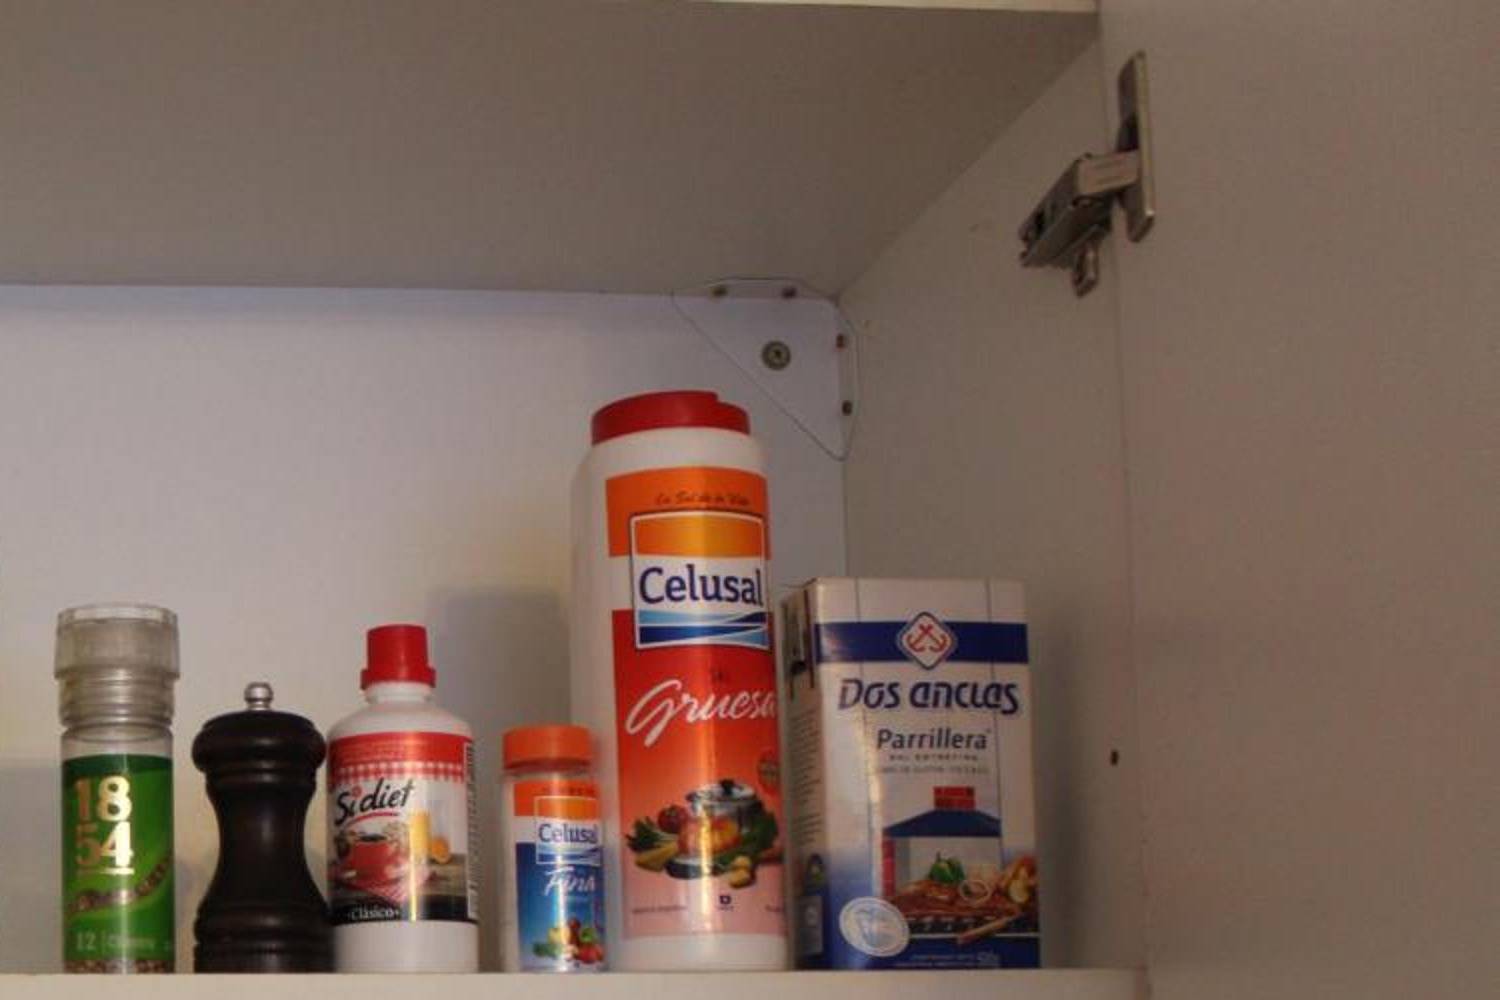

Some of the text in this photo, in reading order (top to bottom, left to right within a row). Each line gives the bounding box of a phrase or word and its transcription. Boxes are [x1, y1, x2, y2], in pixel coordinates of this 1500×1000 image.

[638, 563, 764, 606] Celusal
[624, 678, 775, 747] Gruesa
[876, 728, 988, 750] Parrillera
[75, 775, 132, 821] 18
[335, 778, 415, 827] Sidiet
[76, 820, 134, 868] 54
